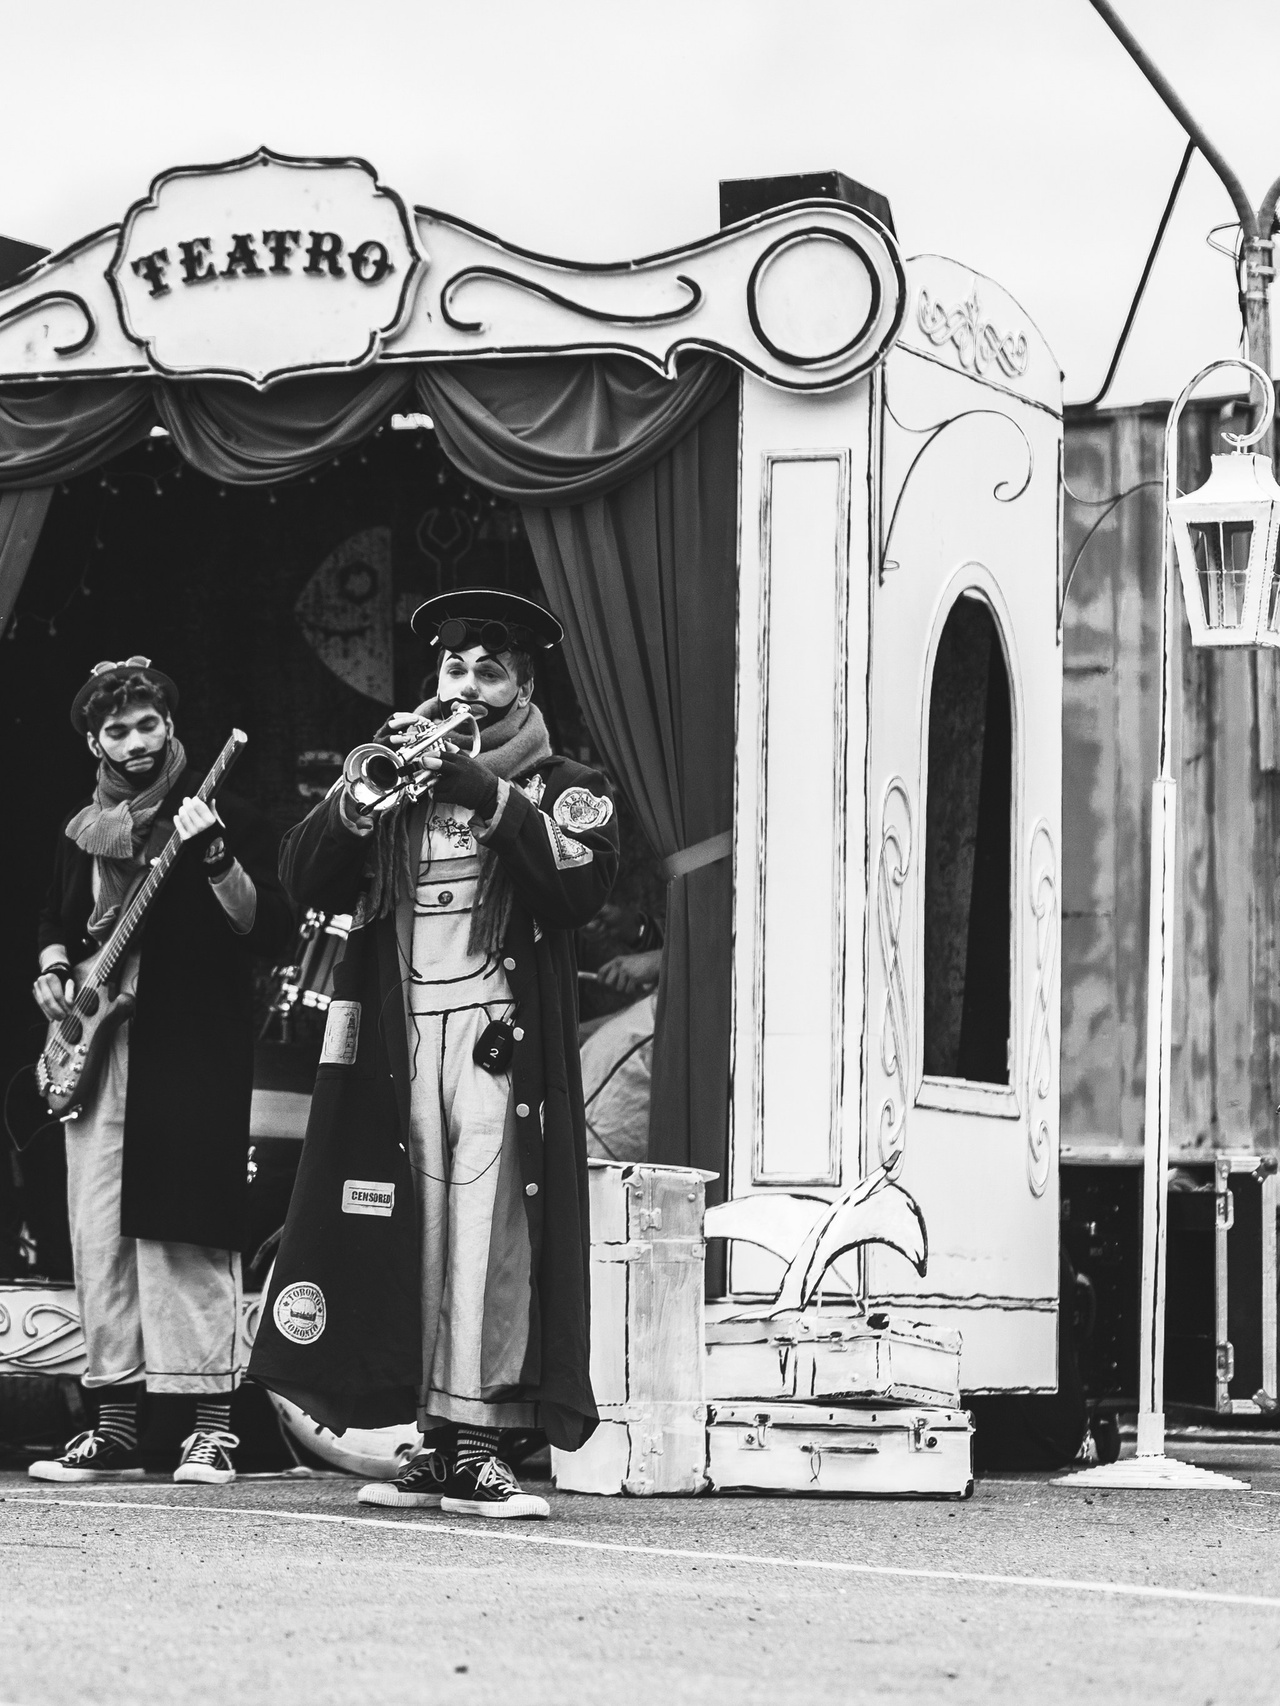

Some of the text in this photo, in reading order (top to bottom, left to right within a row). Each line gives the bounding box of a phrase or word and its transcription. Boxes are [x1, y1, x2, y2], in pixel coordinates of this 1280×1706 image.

[131, 230, 395, 299] TEATRO
[489, 1047, 499, 1059] 2
[351, 1190, 391, 1204] CENSORED
[286, 1288, 321, 1306] TORONTO
[283, 1319, 319, 1337] TORONTO
